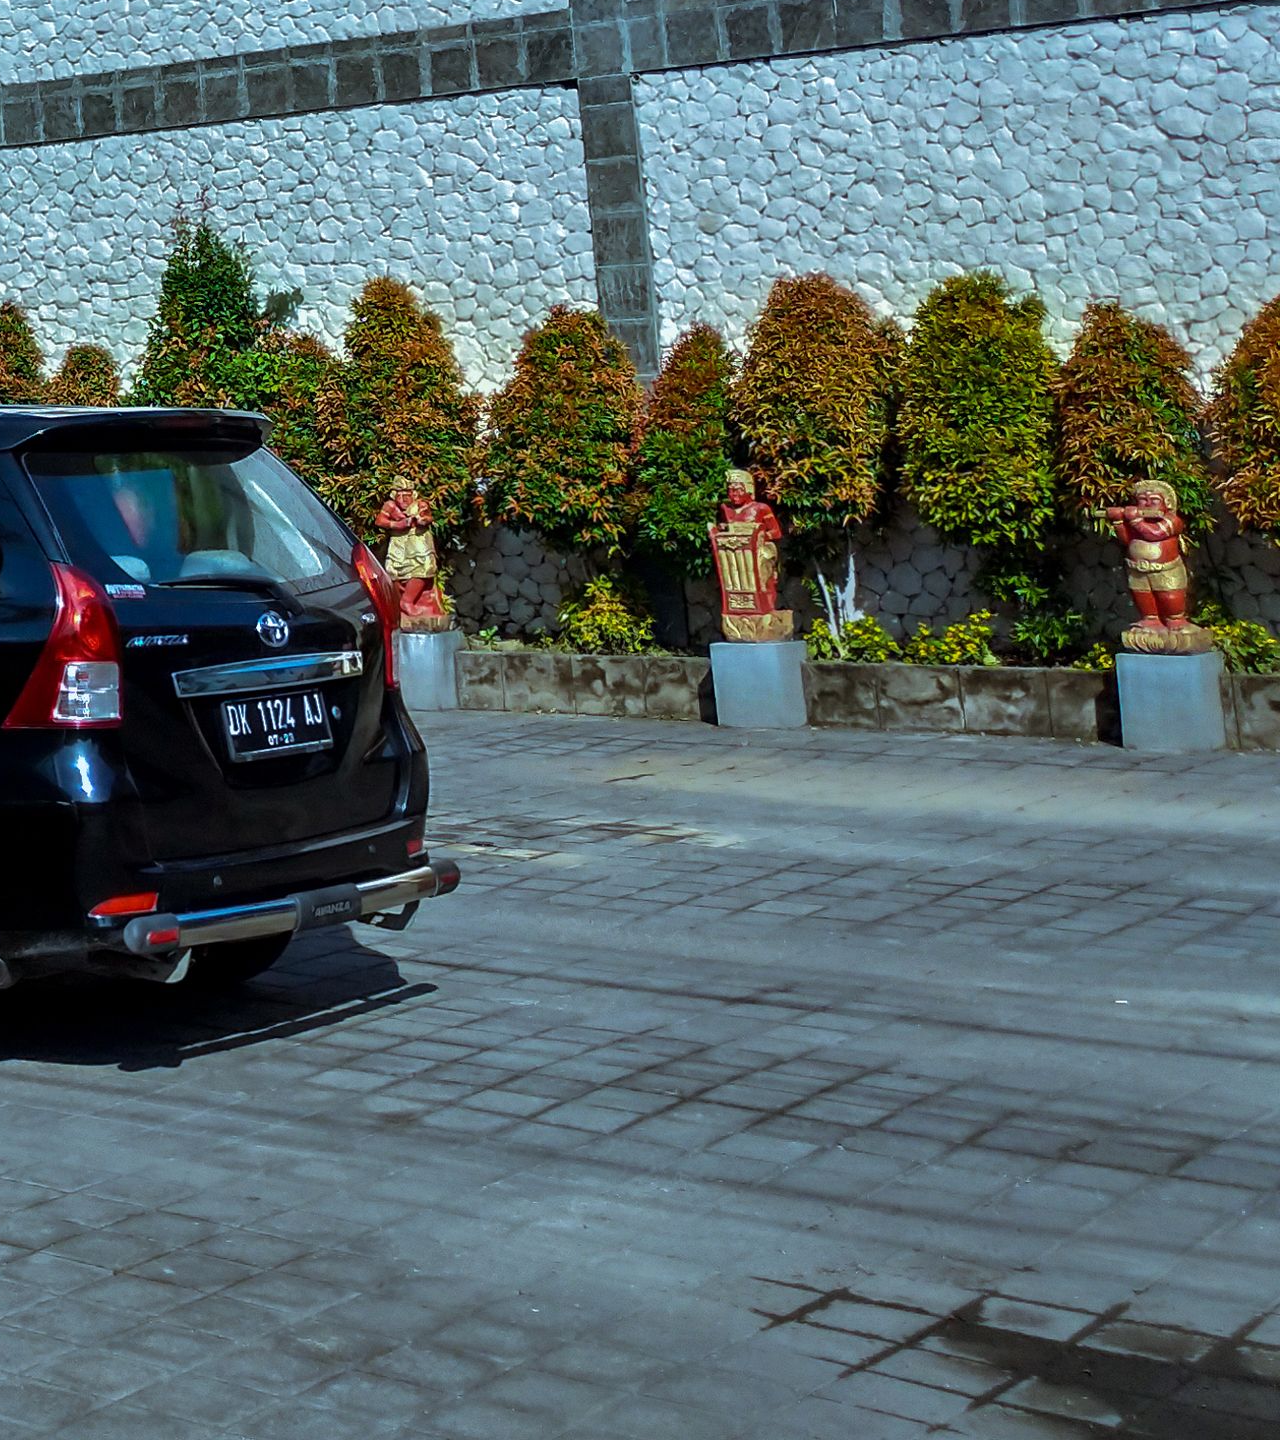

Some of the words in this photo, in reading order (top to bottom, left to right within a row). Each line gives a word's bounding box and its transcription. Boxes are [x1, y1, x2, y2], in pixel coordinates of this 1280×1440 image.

[226, 704, 252, 735] DK
[257, 697, 296, 732] 1124
[303, 693, 322, 726] AJ
